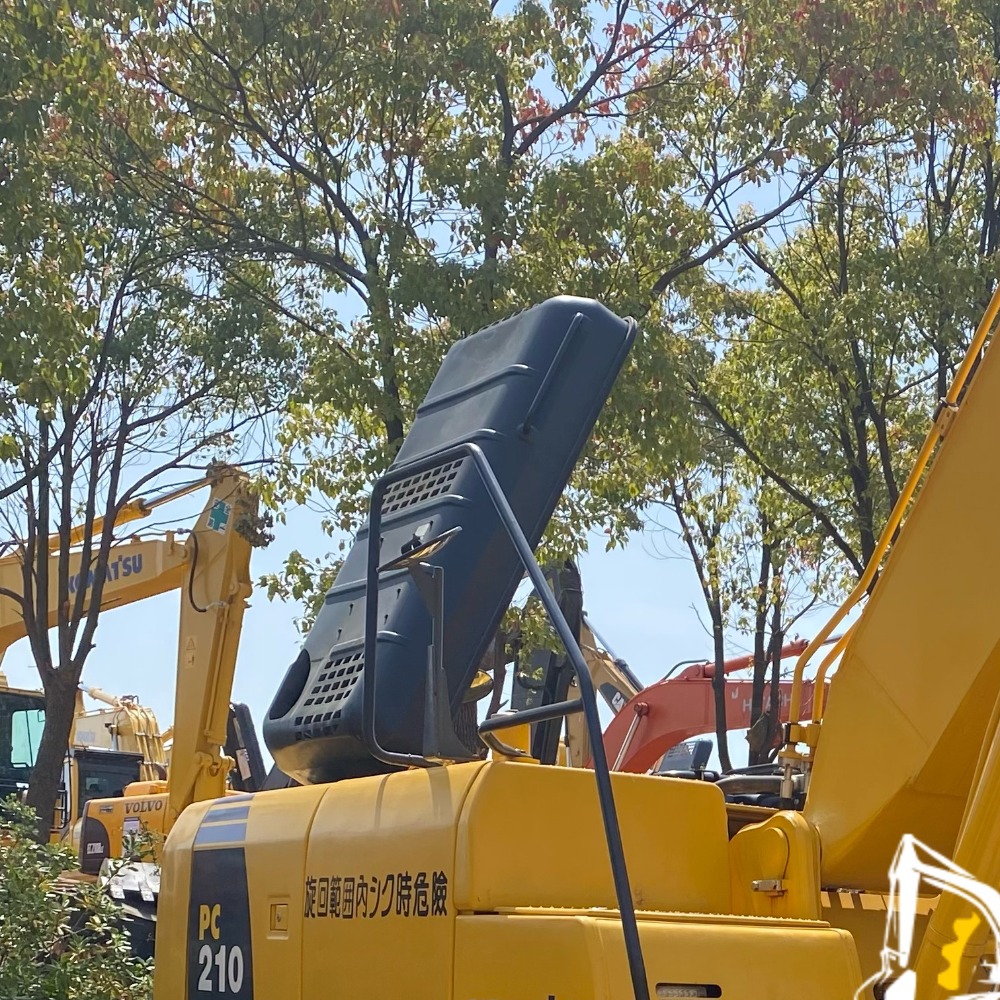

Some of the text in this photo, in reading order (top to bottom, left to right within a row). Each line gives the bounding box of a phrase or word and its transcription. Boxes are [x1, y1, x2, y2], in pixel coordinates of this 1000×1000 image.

[125, 800, 163, 814] VOLVO
[199, 904, 221, 940] PC
[198, 944, 244, 993] 210
